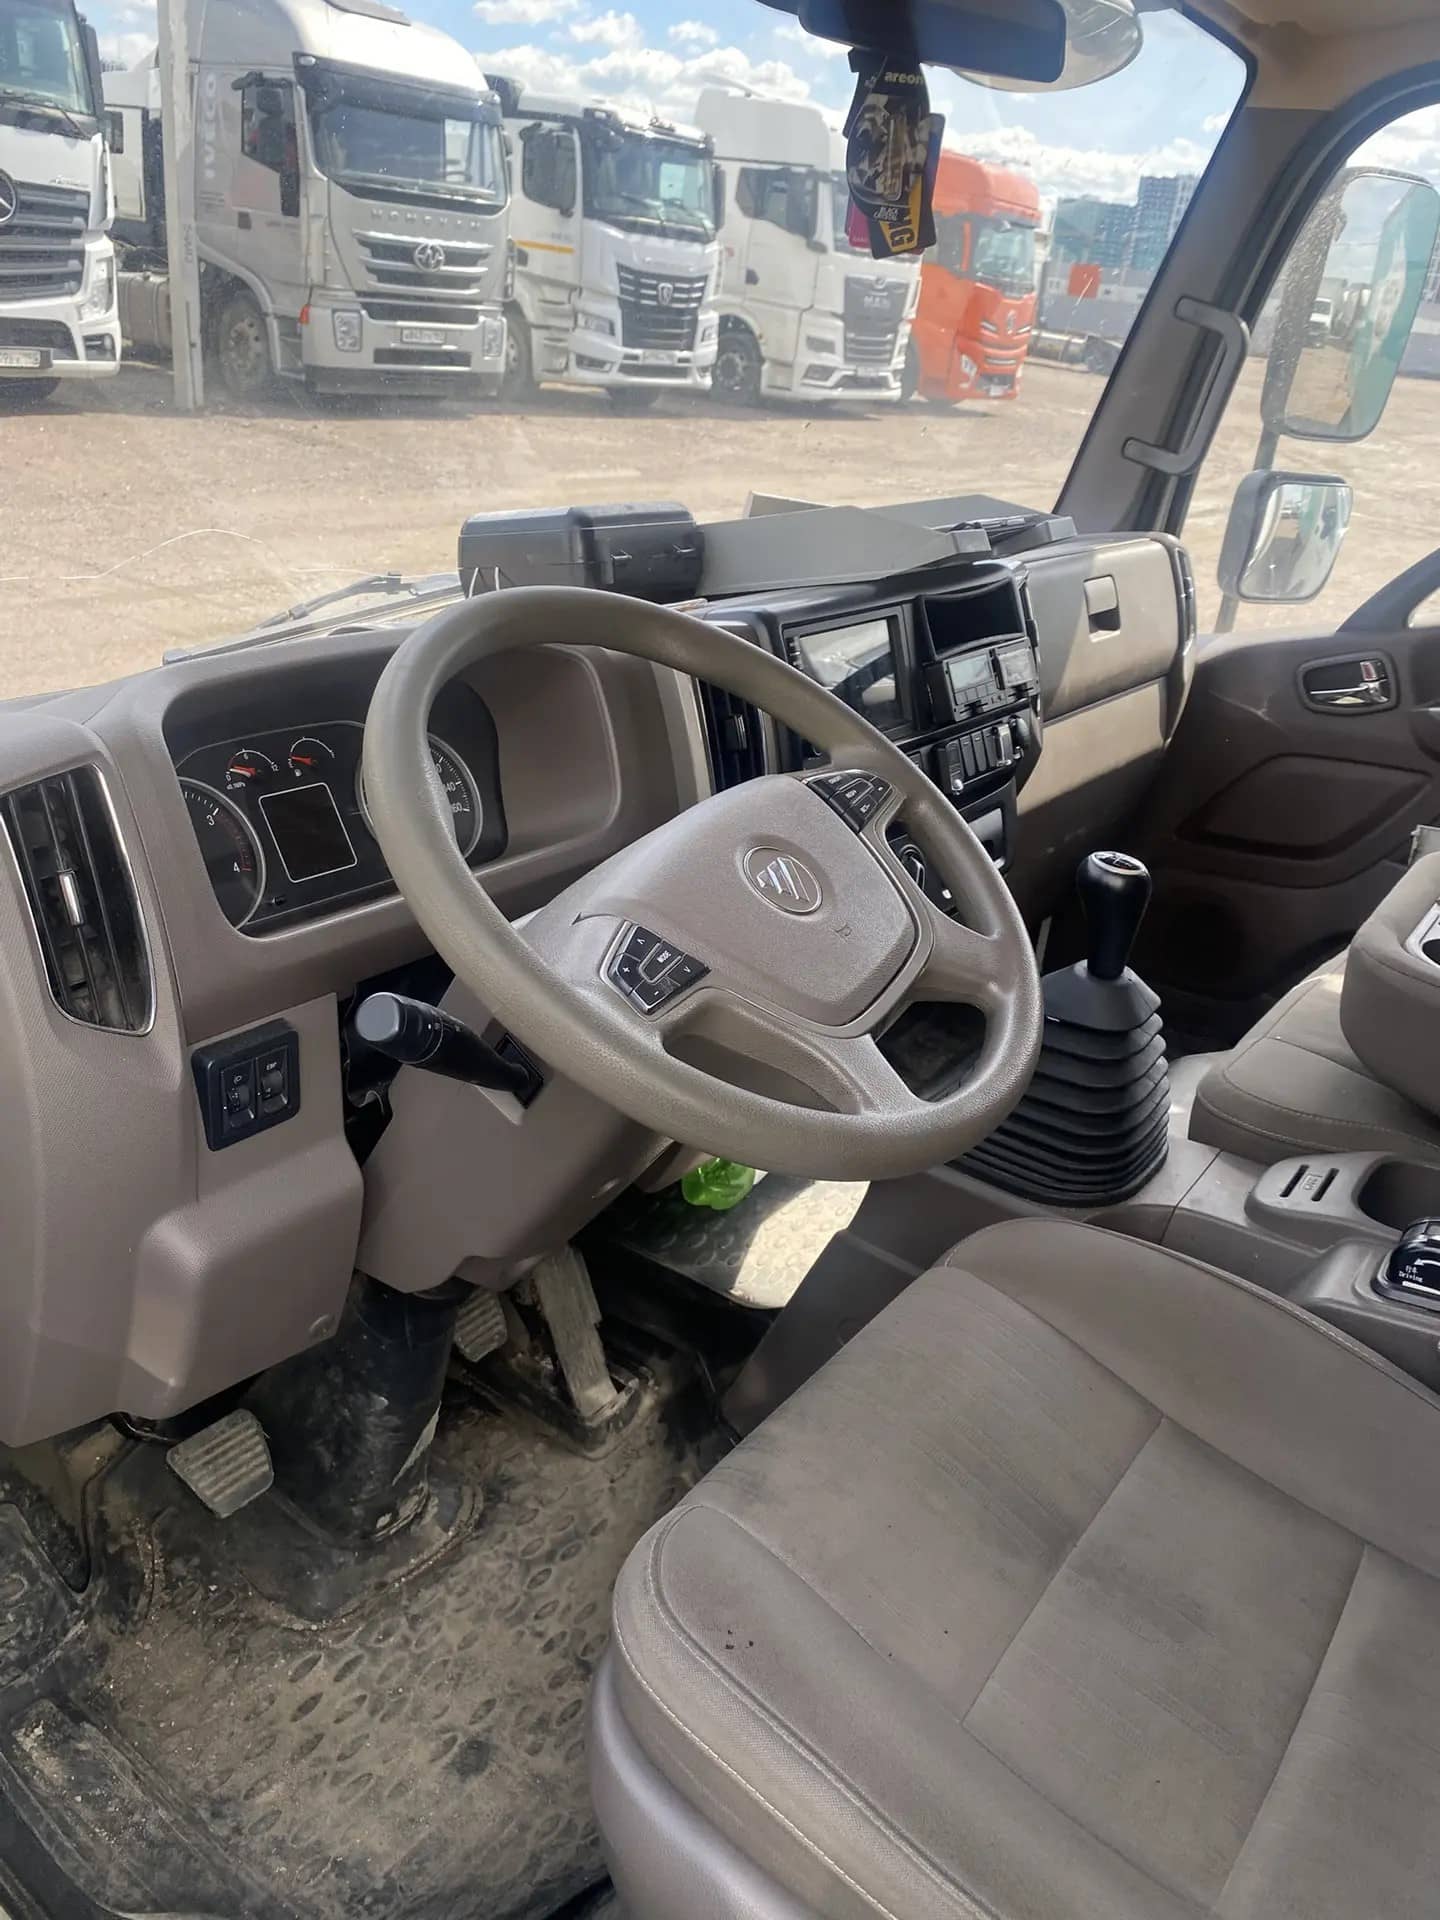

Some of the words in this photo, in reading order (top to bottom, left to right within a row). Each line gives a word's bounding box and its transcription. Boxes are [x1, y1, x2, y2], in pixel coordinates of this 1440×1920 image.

[884, 71, 924, 85] areon
[206, 814, 215, 826] 3
[233, 861, 241, 873] 4
